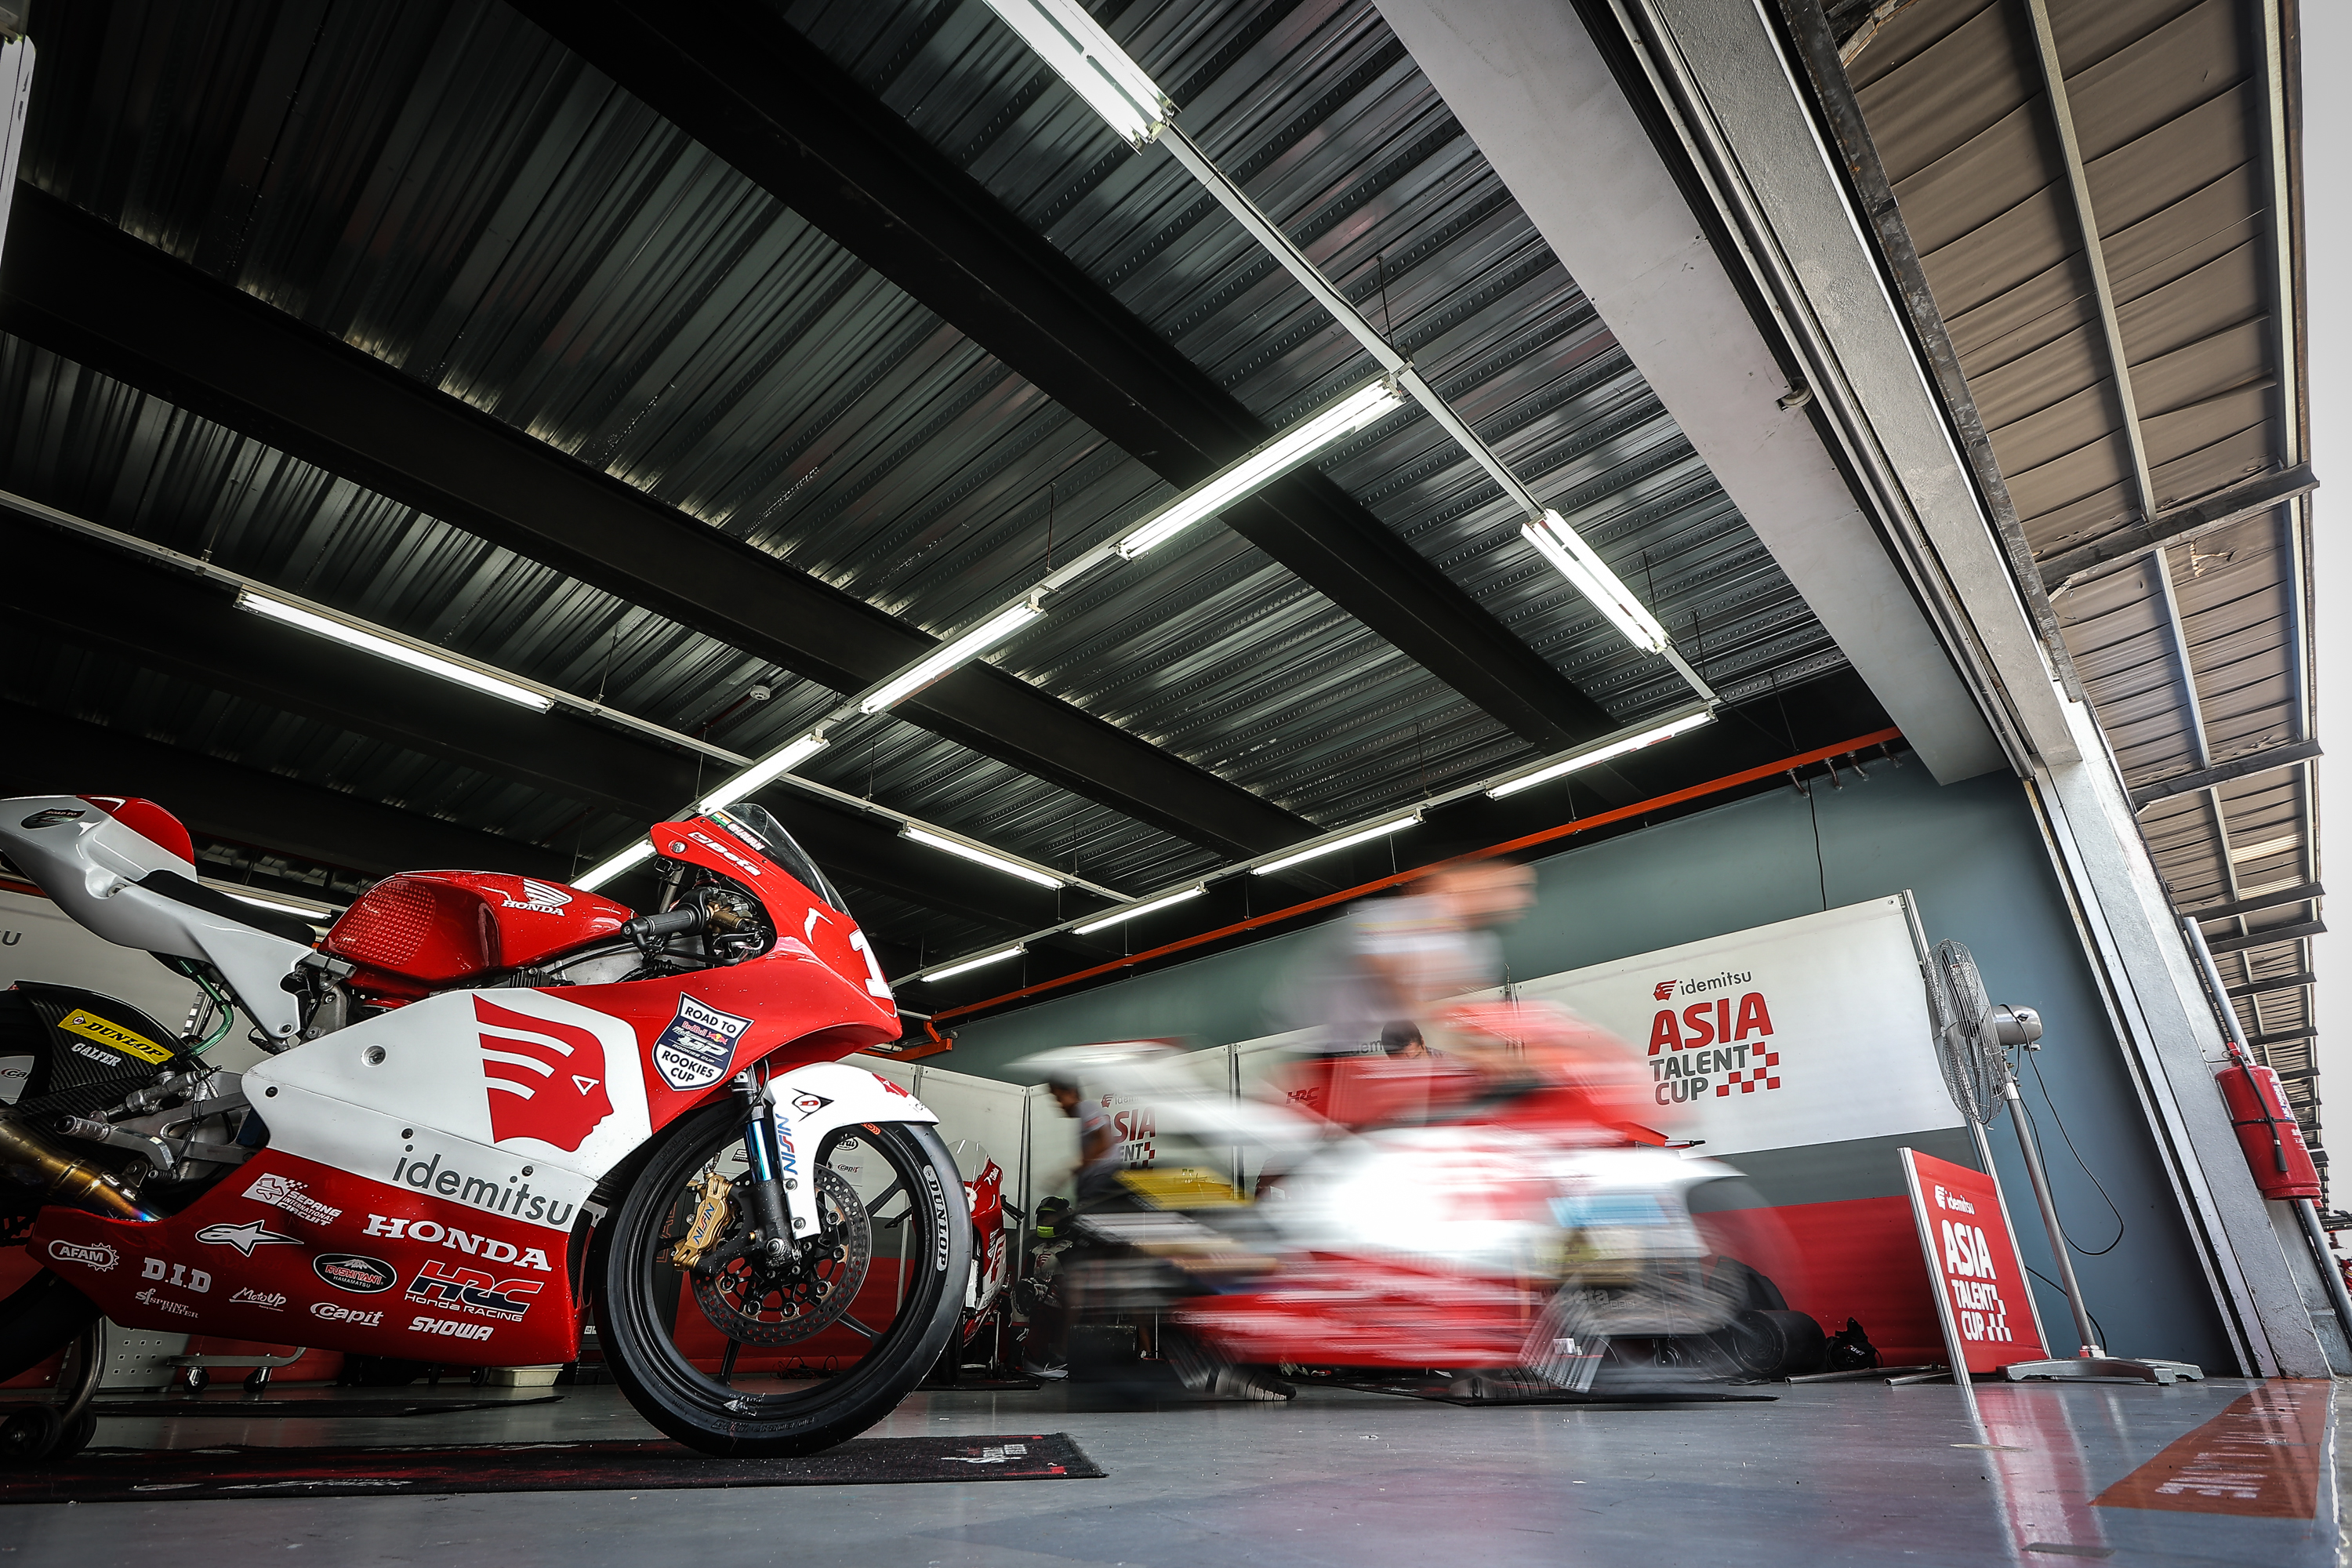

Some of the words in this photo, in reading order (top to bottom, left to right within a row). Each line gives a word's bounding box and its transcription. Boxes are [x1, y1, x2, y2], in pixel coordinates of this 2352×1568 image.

[727, 823, 766, 851] CHAVAN
[501, 900, 565, 916] HONDA
[1679, 971, 1752, 996] idemitsu
[684, 1006, 719, 1026] ROAD
[720, 1021, 736, 1033] TO
[1647, 992, 1774, 1057] ASIA
[85, 1022, 165, 1057] DUNLOP
[71, 1043, 122, 1067] GALFER
[661, 1049, 714, 1079] ROOKIES
[1649, 1044, 1750, 1082] TALENT
[670, 1067, 695, 1082] CUP
[1655, 1076, 1709, 1105] CUP
[392, 1144, 574, 1225] idemitsu
[277, 1202, 332, 1226] CIRCUIT
[282, 1196, 334, 1222] INTERNATIONAL
[287, 1190, 343, 1218] SEPANG
[1945, 1190, 1975, 1215] idemitsu
[928, 1179, 947, 1267] DUNLOP
[59, 1246, 103, 1262] AFAM
[362, 1214, 553, 1272] HONDA
[1941, 1219, 1997, 1280] ASIA
[141, 1257, 212, 1294] D.I.D
[332, 1276, 371, 1288] HAMAMATSU
[405, 1259, 546, 1315] HRC
[149, 1297, 189, 1311] SPRINT
[404, 1293, 460, 1311] Honda
[463, 1305, 524, 1323] RACING
[1951, 1279, 1995, 1312] TALENT
[160, 1304, 199, 1319] FILTER
[1961, 1310, 1985, 1341] CUP
[408, 1316, 495, 1341] SHOWA
